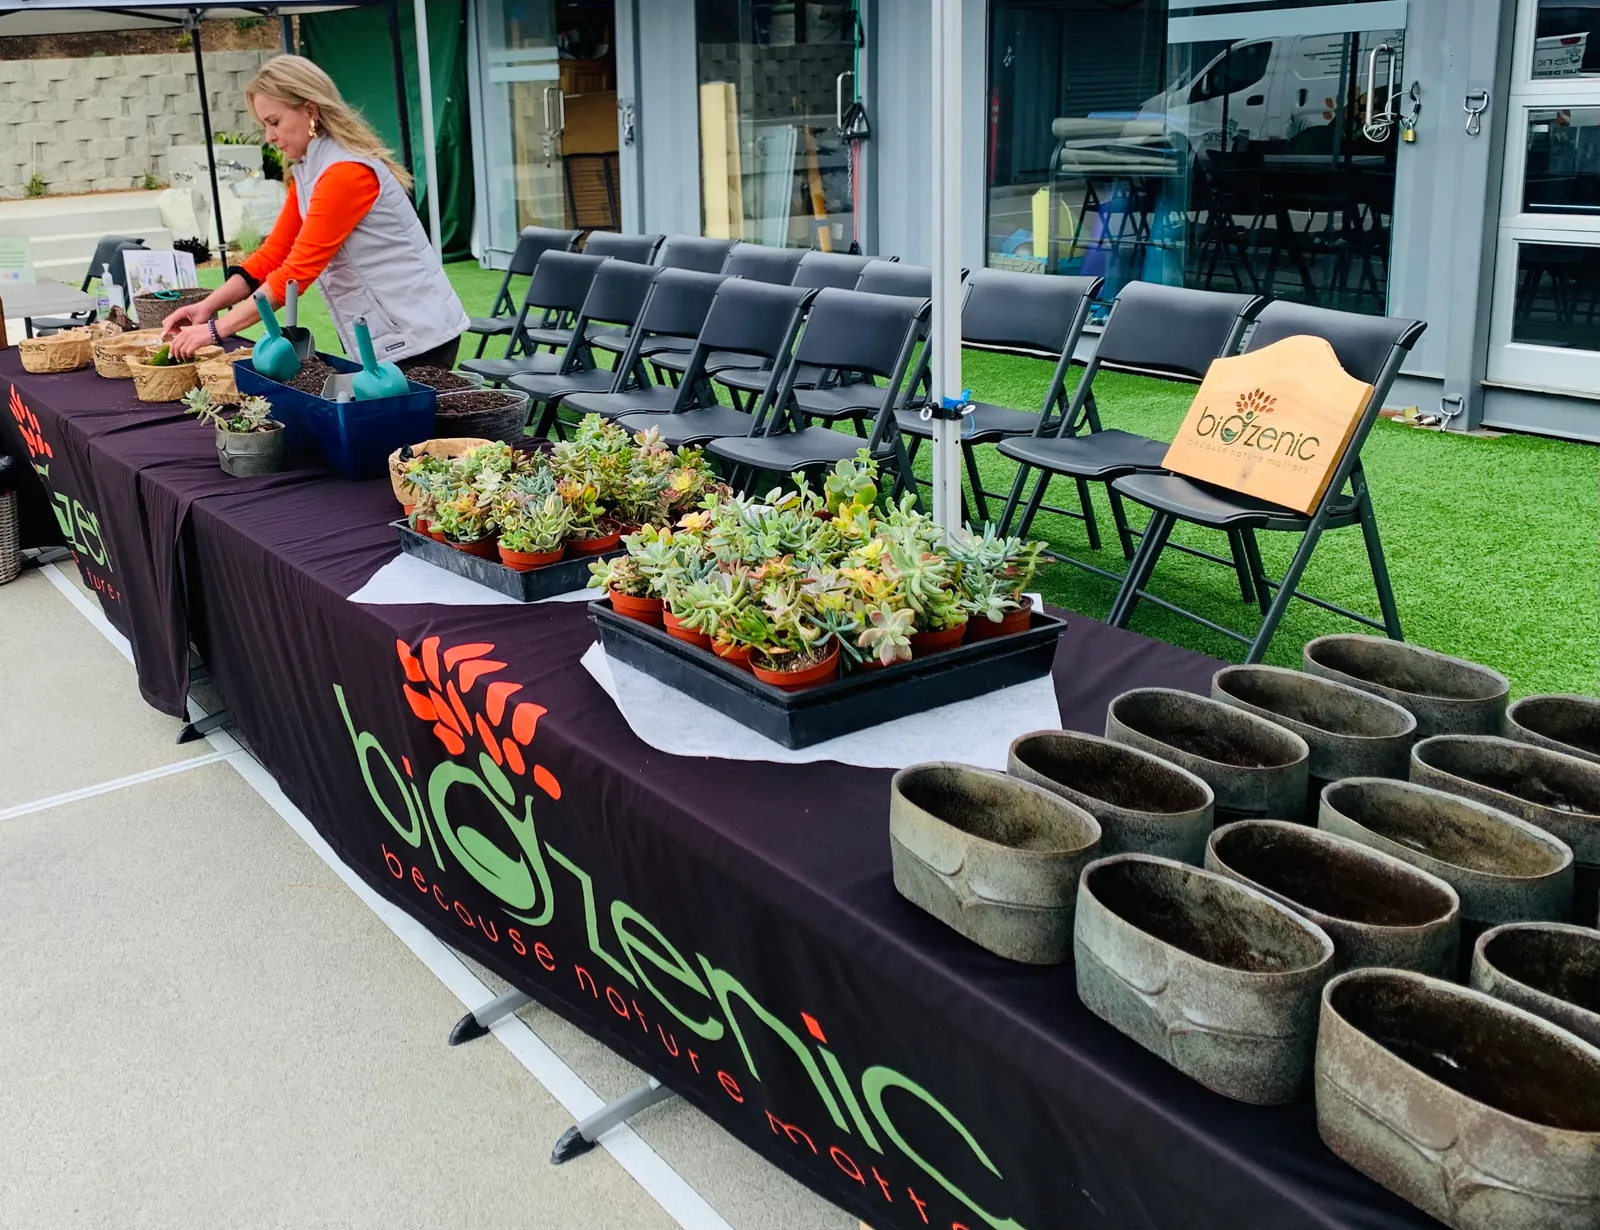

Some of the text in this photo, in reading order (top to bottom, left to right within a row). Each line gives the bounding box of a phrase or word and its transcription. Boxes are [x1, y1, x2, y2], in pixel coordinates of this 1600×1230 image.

[1187, 438, 1309, 473] because nature matters
[1196, 406, 1320, 461] biozenic
[333, 684, 1027, 1230] biozenic
[381, 843, 969, 1230] because nature matt
